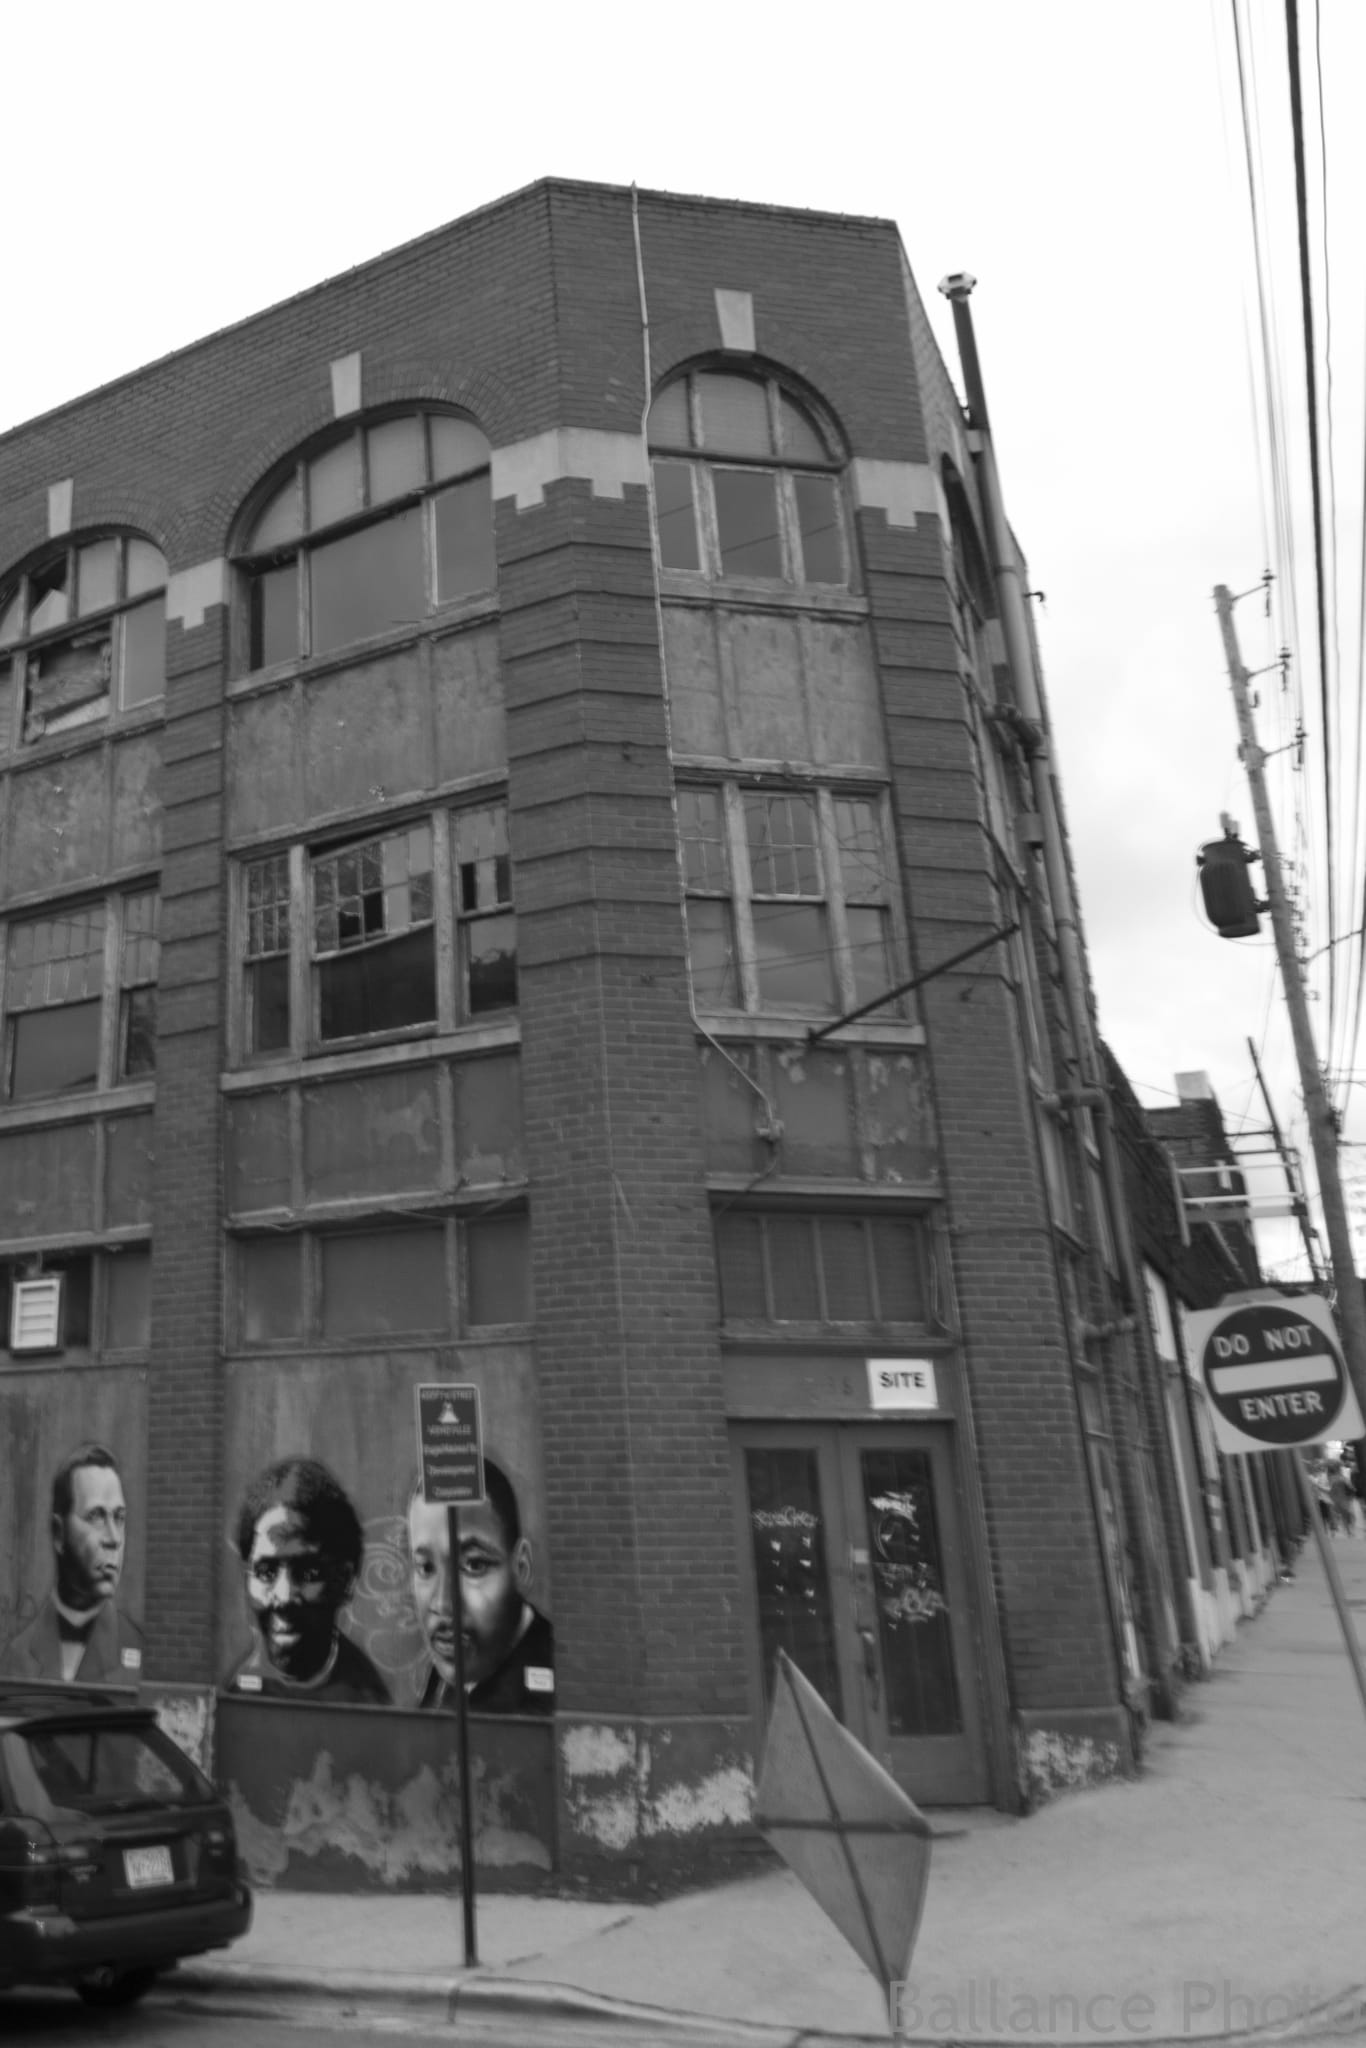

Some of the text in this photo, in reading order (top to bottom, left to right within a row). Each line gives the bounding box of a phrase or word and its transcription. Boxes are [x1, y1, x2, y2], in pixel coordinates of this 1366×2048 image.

[1212, 1325, 1312, 1358] DO NOT
[880, 1372, 926, 1389] SITE
[1239, 1391, 1323, 1421] ENTER
